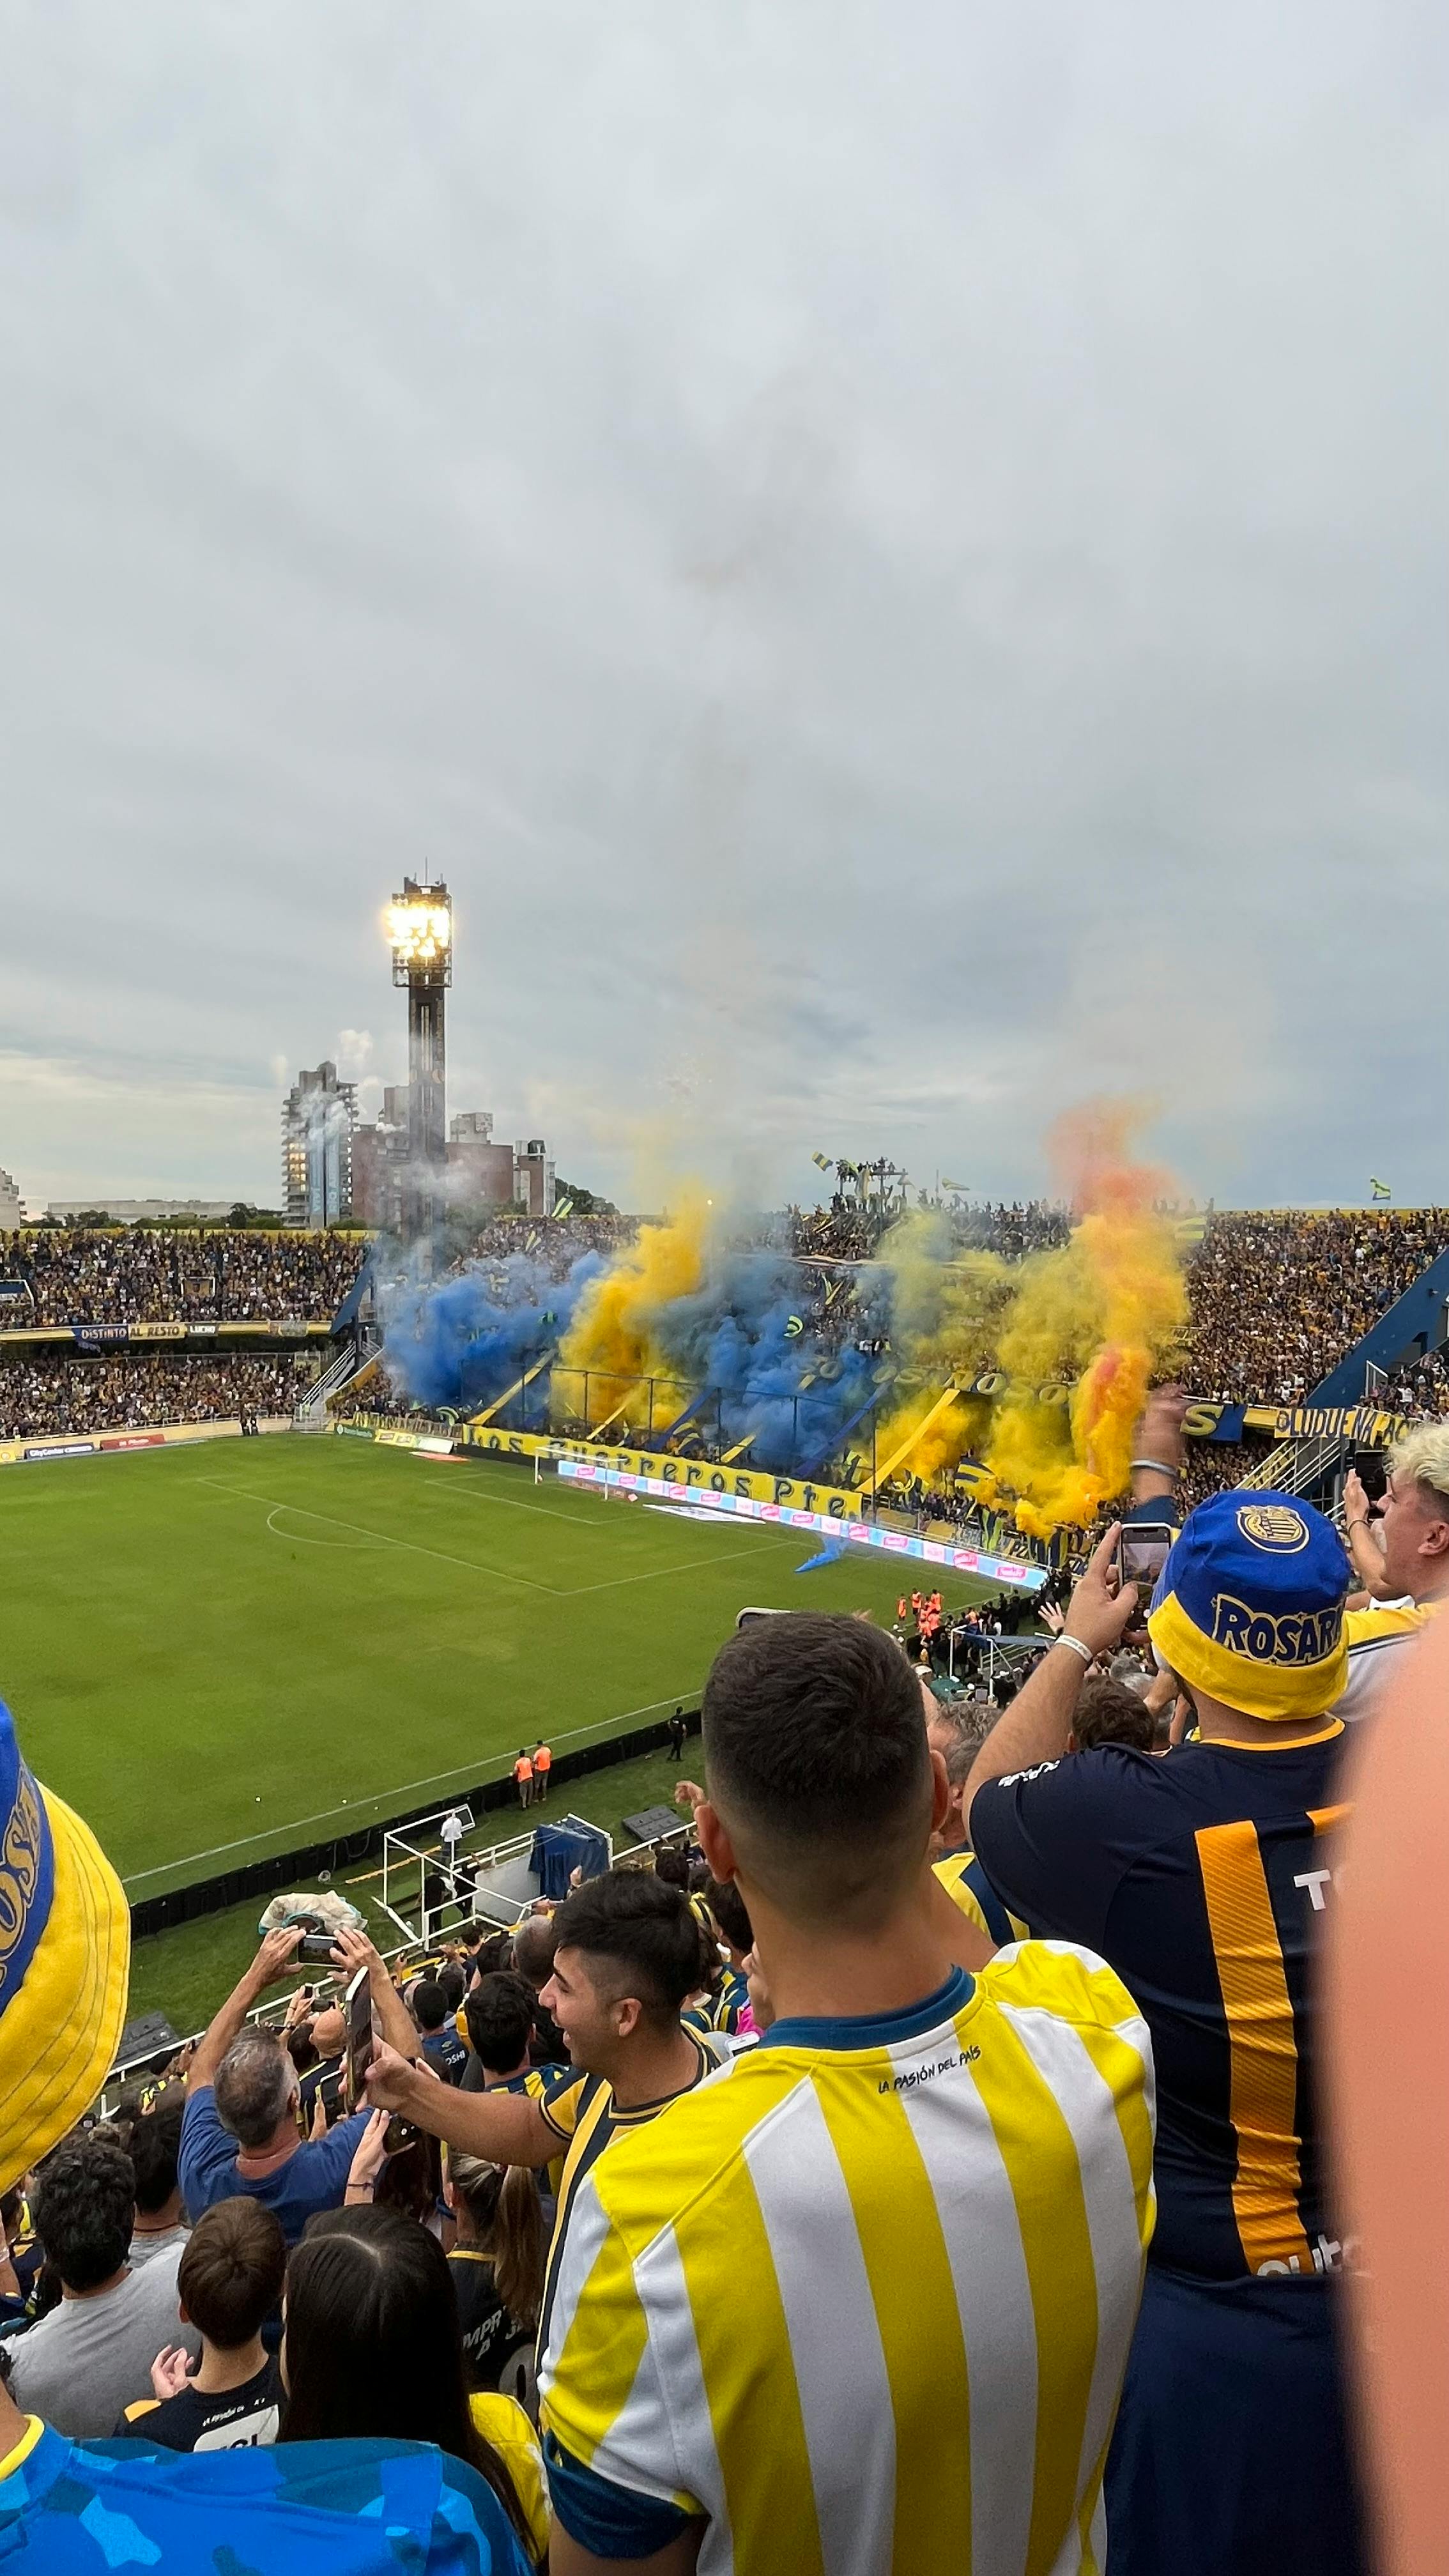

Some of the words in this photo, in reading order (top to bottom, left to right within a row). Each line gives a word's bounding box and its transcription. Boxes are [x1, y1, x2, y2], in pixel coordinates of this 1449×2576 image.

[130, 1326, 143, 1337] AL
[147, 1326, 180, 1337] RESTO
[878, 2080, 889, 2094] LA
[893, 2064, 935, 2091] PASIÓN
[938, 2056, 958, 2074] DEL
[959, 2044, 981, 2066] PAÍS
